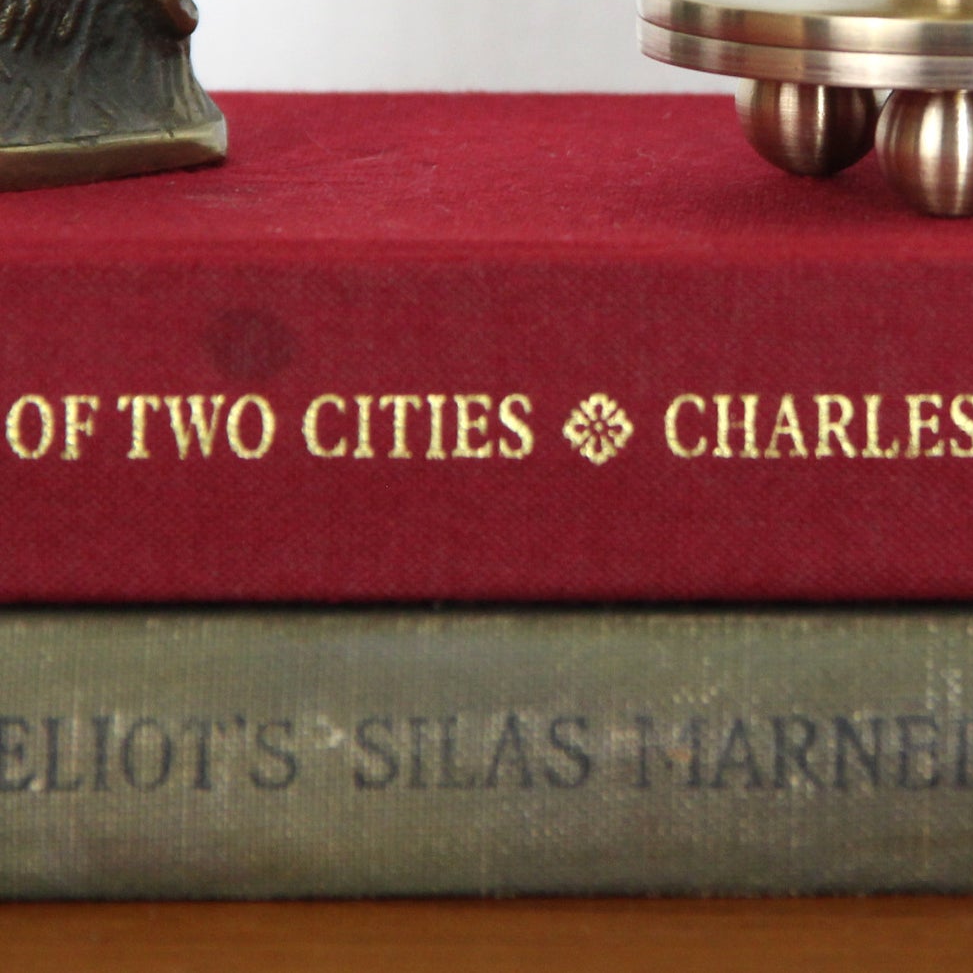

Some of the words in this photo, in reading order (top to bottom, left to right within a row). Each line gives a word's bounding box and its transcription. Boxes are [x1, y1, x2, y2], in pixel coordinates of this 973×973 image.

[6, 394, 100, 460] OF
[116, 394, 276, 460] TWO
[301, 393, 535, 459] CITIES
[0, 713, 298, 792] ELIOT'S
[354, 715, 591, 790] SILAS
